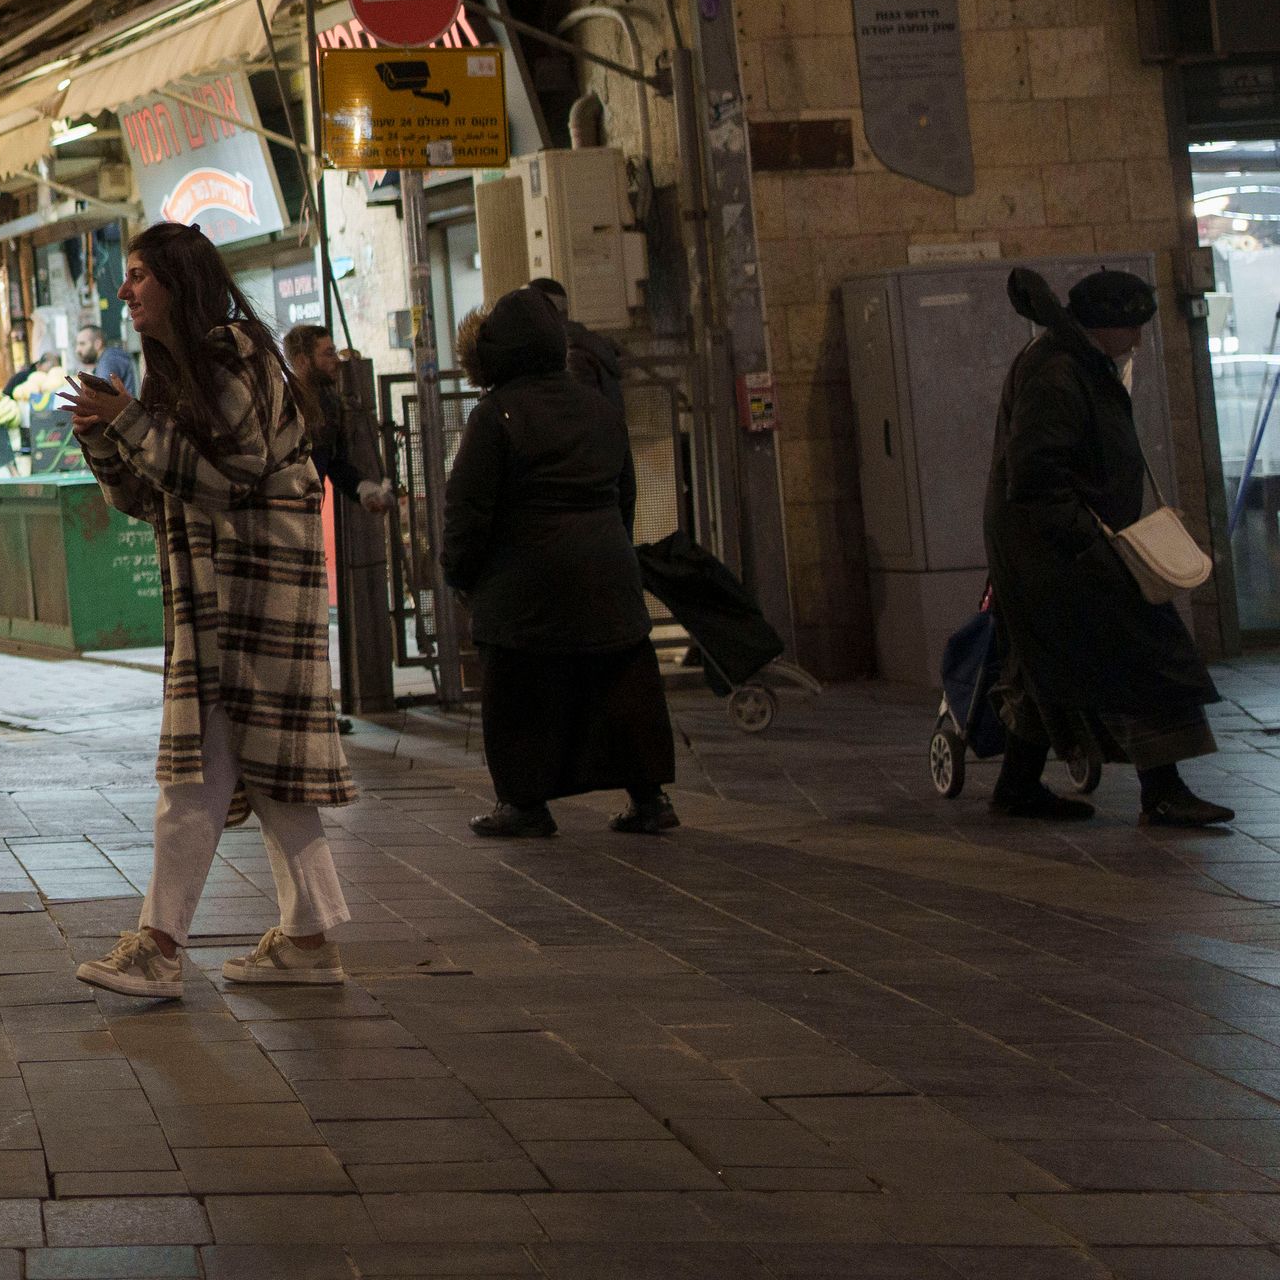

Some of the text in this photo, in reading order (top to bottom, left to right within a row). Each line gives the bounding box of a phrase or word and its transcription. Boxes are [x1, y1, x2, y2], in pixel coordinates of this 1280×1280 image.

[178, 75, 245, 151] אחים
[400, 117, 411, 127] 24
[385, 147, 414, 157] CCTV
[453, 146, 498, 157] ERATION
